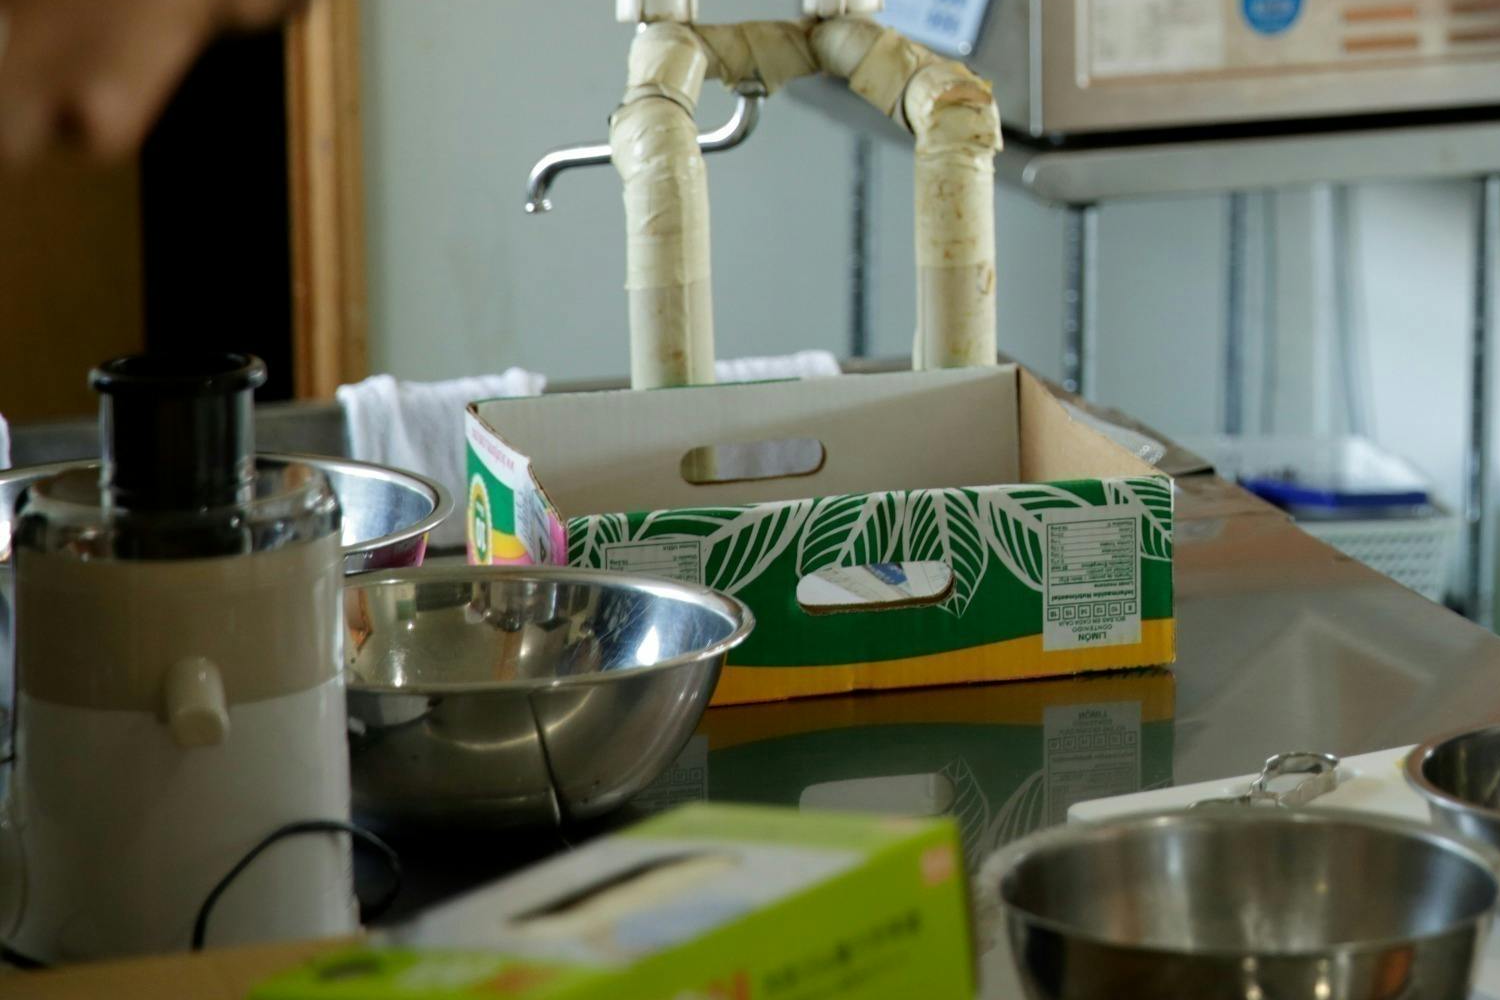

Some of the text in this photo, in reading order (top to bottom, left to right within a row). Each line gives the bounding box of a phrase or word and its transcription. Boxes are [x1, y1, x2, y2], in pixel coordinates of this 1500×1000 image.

[1051, 593, 1092, 601] Nutrimental
[1072, 623, 1112, 632] CONTENIDO
[1078, 631, 1106, 642] LIMÓN
